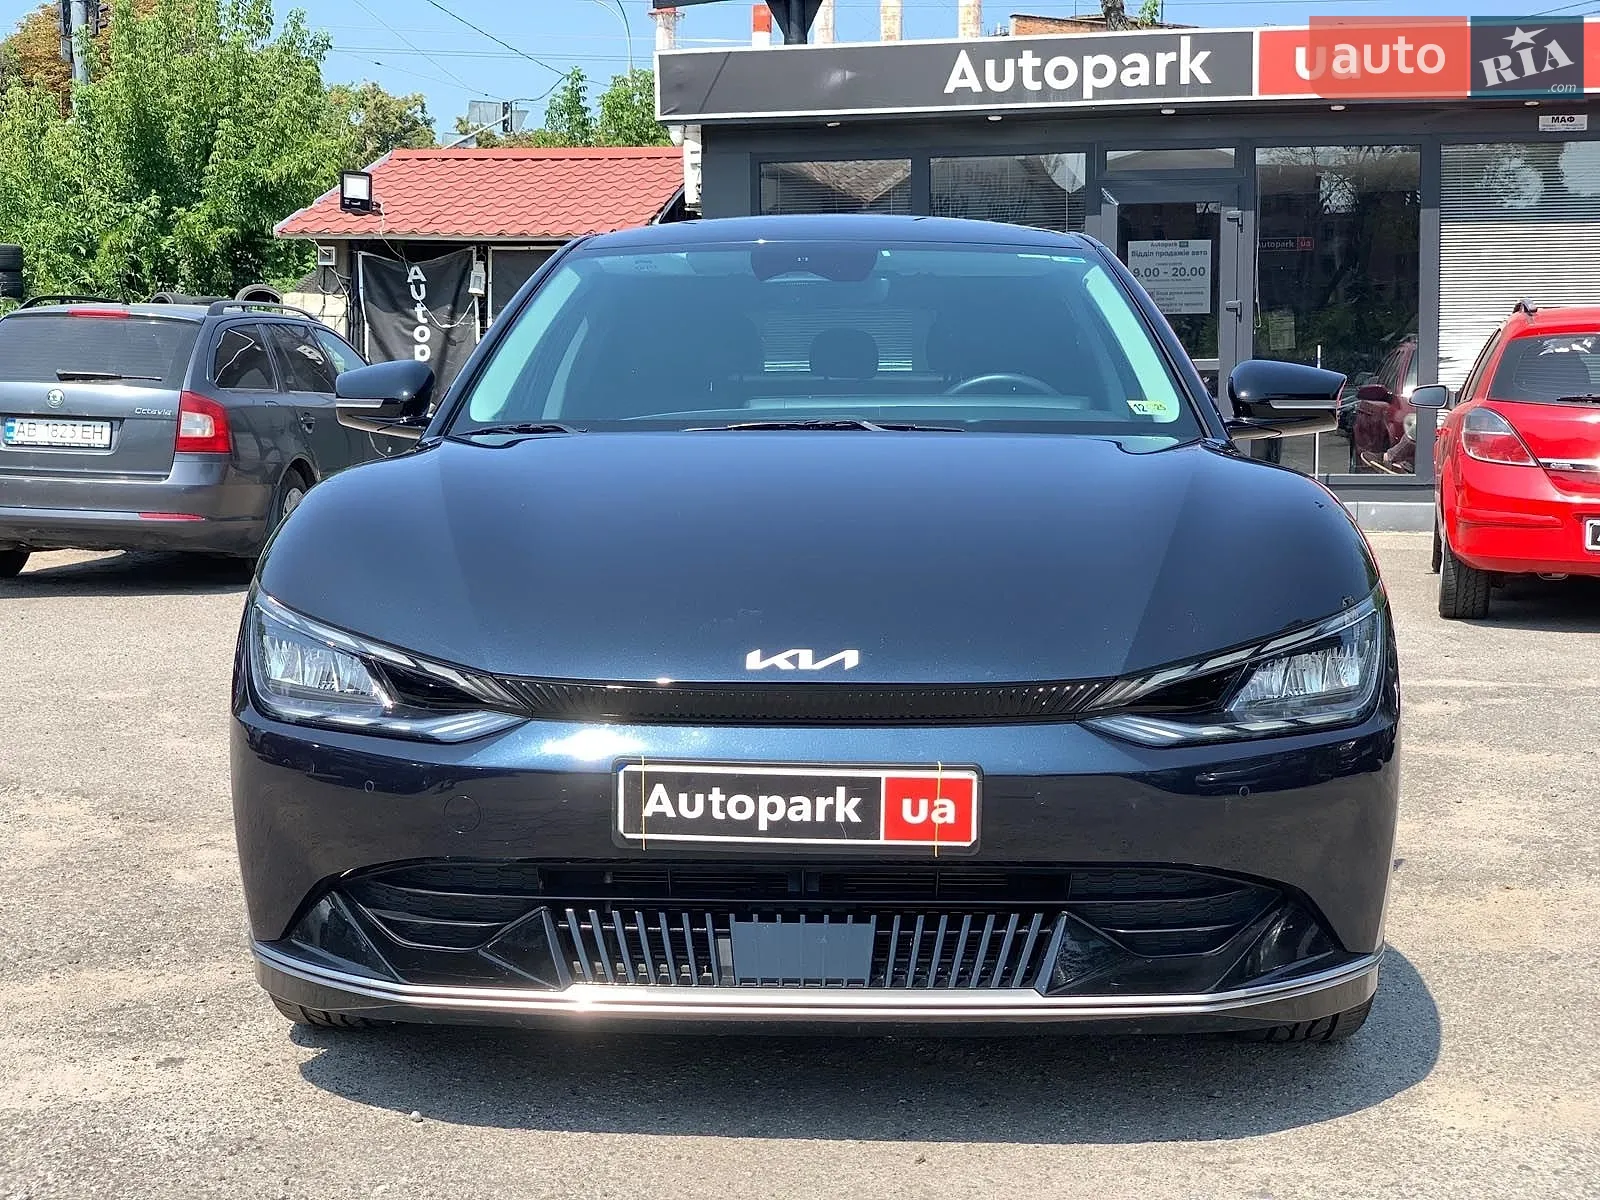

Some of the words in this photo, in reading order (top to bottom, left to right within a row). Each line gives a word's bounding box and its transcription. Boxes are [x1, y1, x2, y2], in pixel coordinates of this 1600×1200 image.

[943, 36, 1212, 99] Autopark
[1551, 116, 1576, 124] МАФ
[1172, 266, 1206, 277] 20.00
[16, 421, 37, 437] AB
[45, 423, 77, 439] 1823
[81, 424, 104, 440] EH
[745, 648, 859, 671] KIA
[643, 783, 862, 831] Autopark
[901, 796, 957, 825] ua
